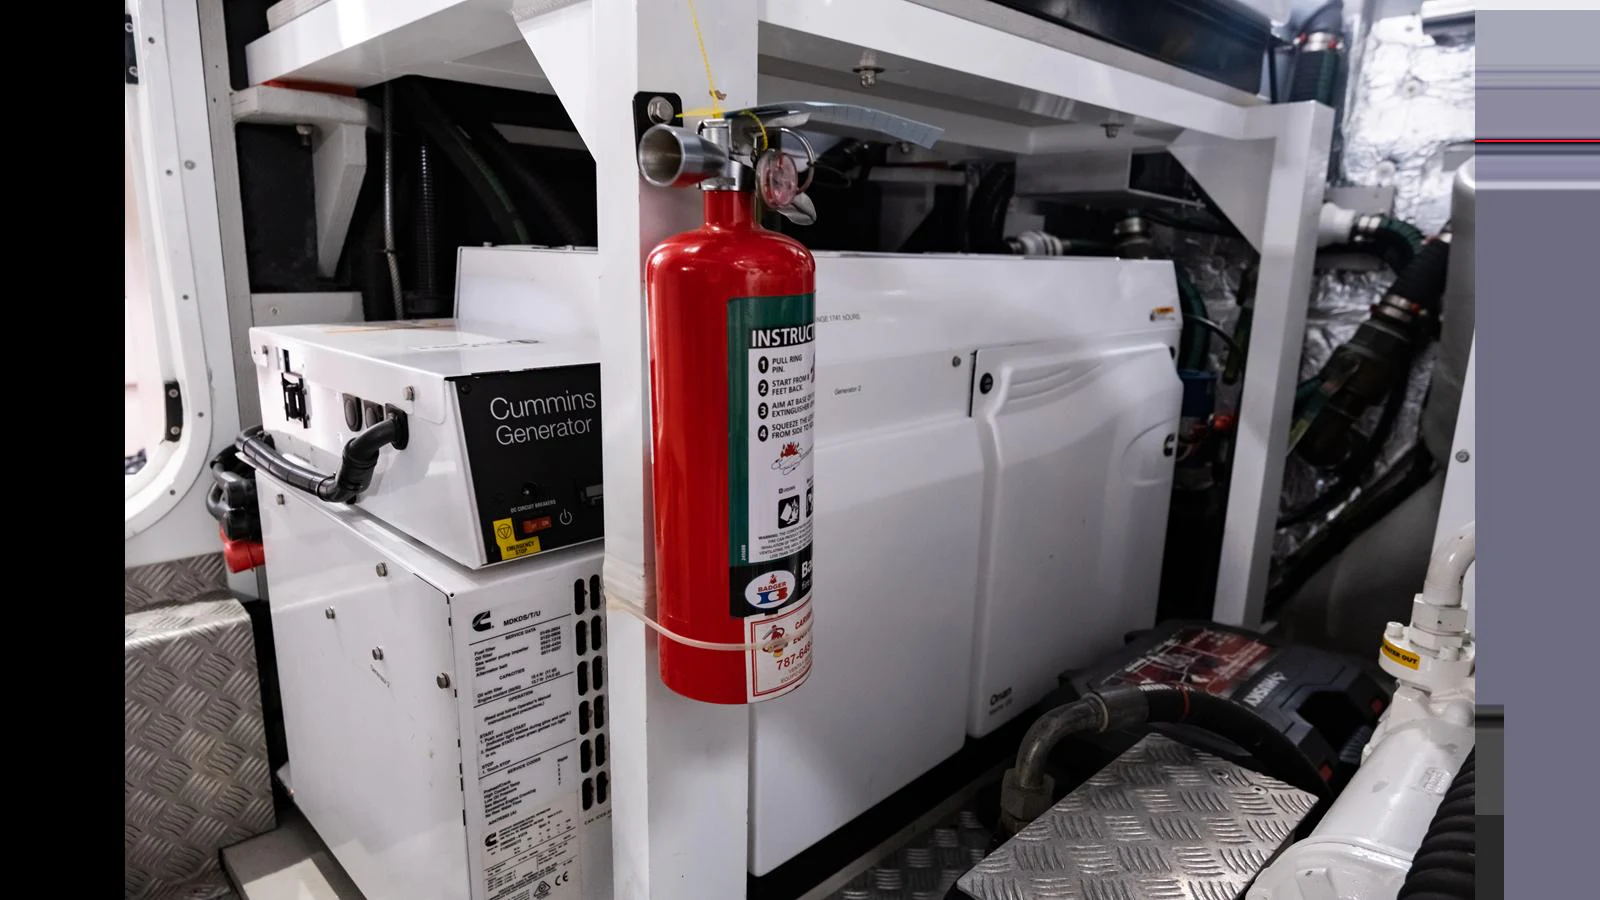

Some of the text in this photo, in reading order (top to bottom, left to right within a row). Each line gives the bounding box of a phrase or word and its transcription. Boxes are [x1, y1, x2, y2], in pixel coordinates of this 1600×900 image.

[789, 354, 802, 362] RING
[772, 378, 791, 387] START
[490, 390, 596, 420] Cummins
[772, 420, 798, 431] SQUEEZE
[496, 418, 592, 445] Generator
[772, 430, 790, 439] FROM
[792, 427, 802, 436] SIDE
[518, 504, 534, 512] CIRCUIT
[535, 499, 556, 508] BREAKERS
[506, 540, 534, 552] EMERGENCY
[516, 547, 528, 555] STOP
[758, 582, 787, 592] BADGER
[503, 610, 540, 626] MDKDS/T/U
[505, 631, 523, 640] SERVICE
[511, 646, 528, 655] impeller
[1401, 654, 1417, 664] OUT
[476, 667, 498, 677] Alternator
[499, 668, 524, 680] CAPACITIES
[477, 695, 491, 703] Engine
[492, 690, 507, 698] coolant
[508, 690, 533, 702] OPERATION
[479, 730, 493, 738] START
[485, 744, 500, 753] Release
[507, 764, 525, 774] SERVICE
[494, 785, 509, 795] Coolant
[499, 787, 516, 797] Pressure
[506, 796, 518, 804] Engine
